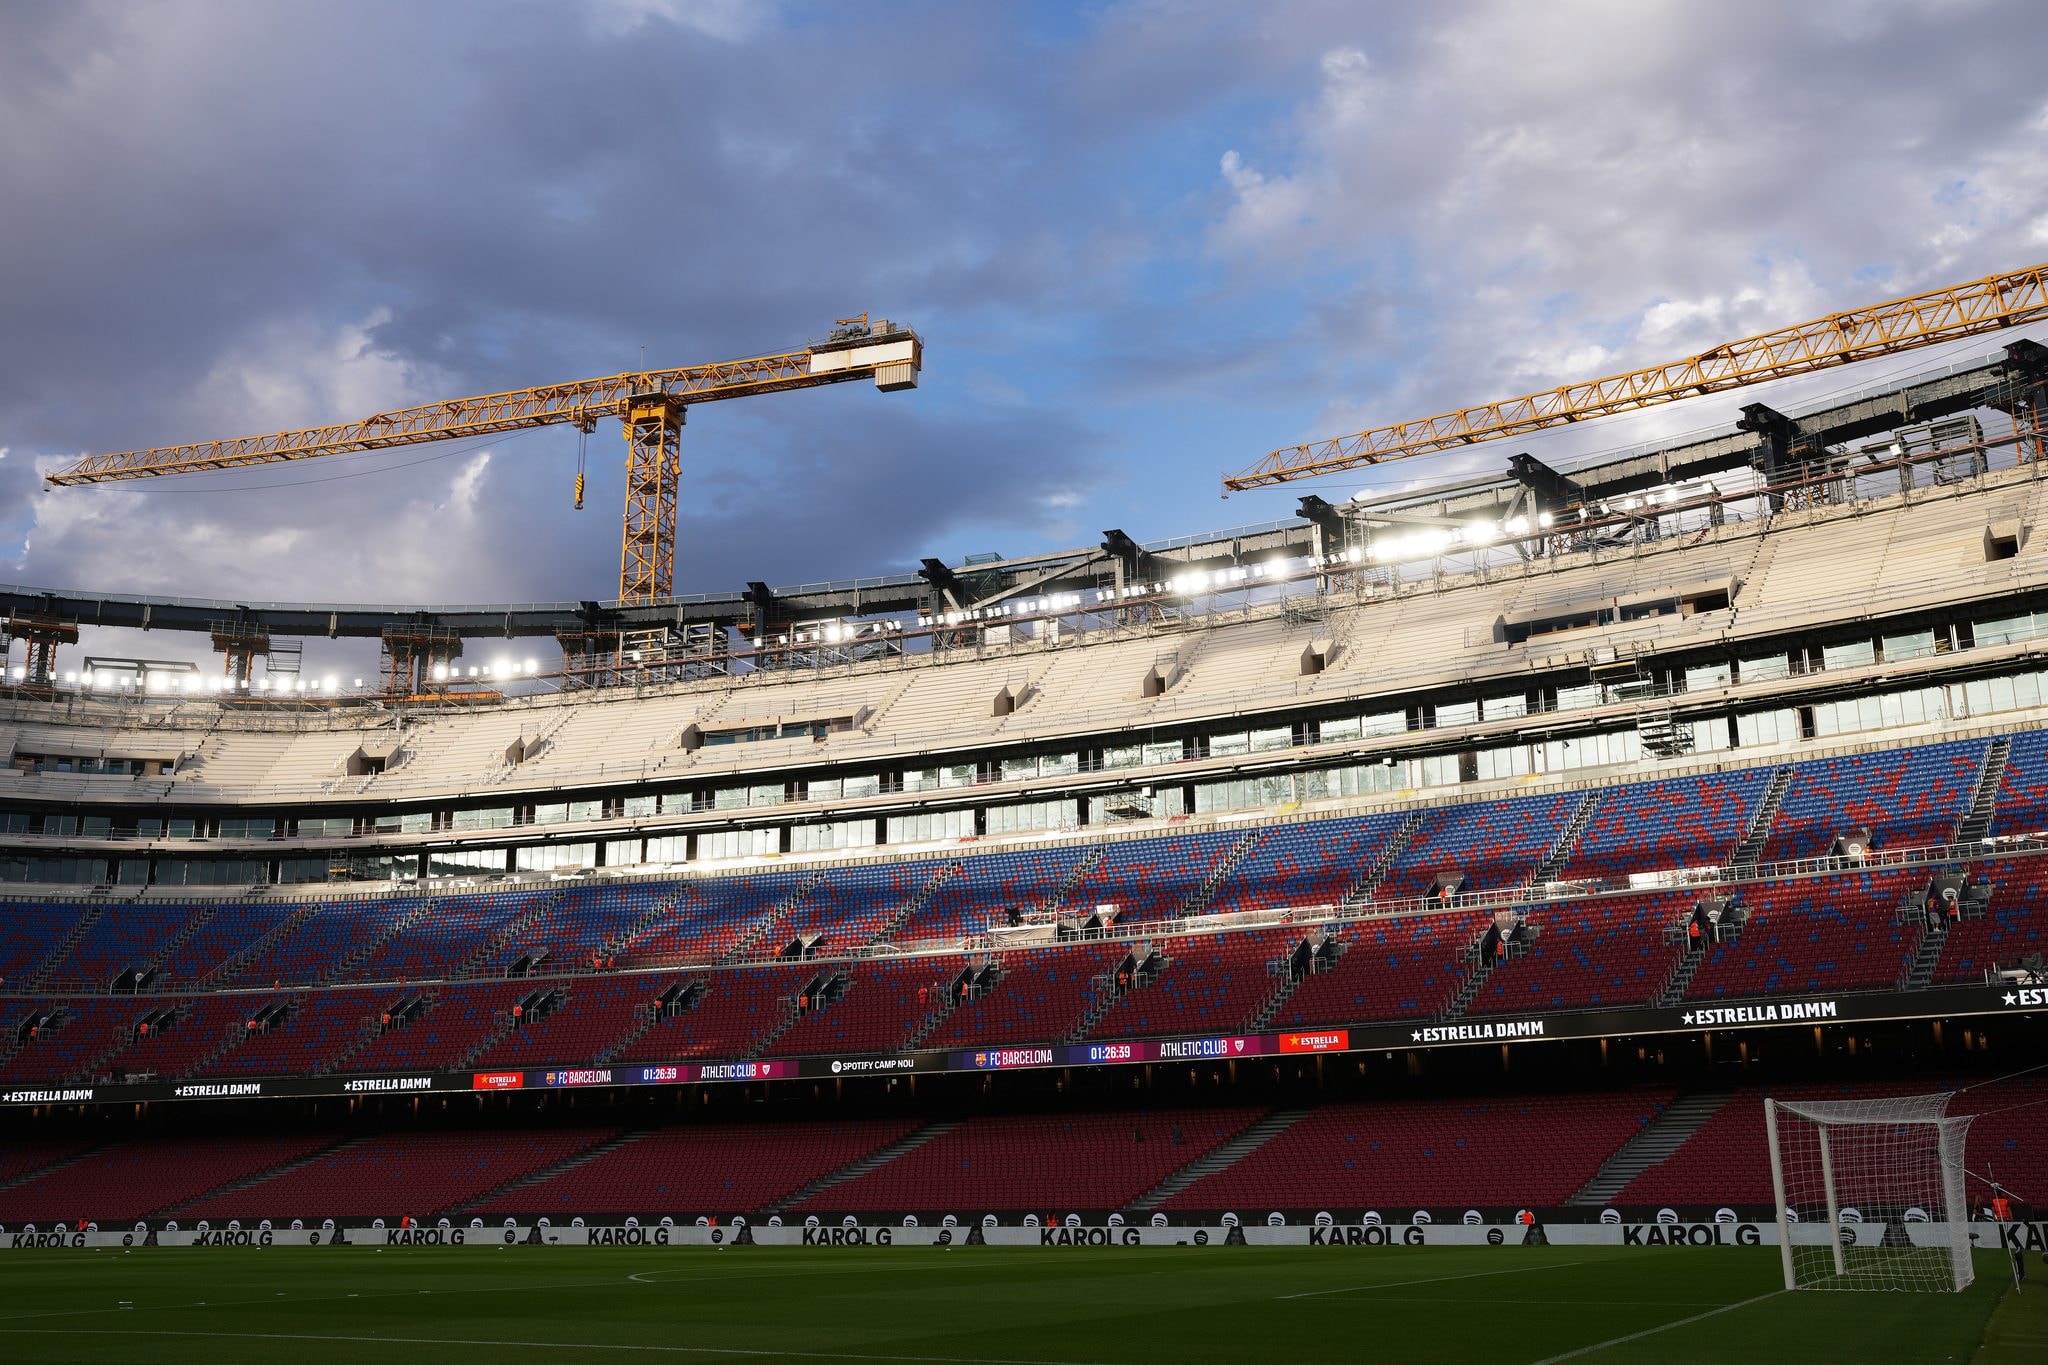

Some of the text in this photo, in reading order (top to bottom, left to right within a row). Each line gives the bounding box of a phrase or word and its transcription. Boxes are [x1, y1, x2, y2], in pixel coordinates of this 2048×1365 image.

[1695, 1001, 1837, 1025] ESTRELLA DAMM
[1423, 1020, 1545, 1042] ESTRELLA DAMM
[1300, 1035, 1339, 1045] ESTRELLA
[1090, 1045, 1131, 1060] 01:26:39
[1160, 1039, 1228, 1058] ATHLETIC CLUB
[842, 1059, 914, 1071] SPOTIFY CAMP NOU
[990, 1049, 1053, 1066] FC BARCELONA
[558, 1069, 612, 1085] FC BARCELONA
[643, 1067, 677, 1081] 01:26:39
[700, 1063, 757, 1079] ATHLETIC CLUB
[351, 1077, 432, 1091] ESTRELLA DAMM
[488, 1076, 517, 1084] ESTRELLA
[11, 1089, 93, 1102] ESTRELLA DAMM
[182, 1083, 261, 1097] ESTRELLA DAMM
[12, 1234, 85, 1248] KAROL G
[201, 1231, 272, 1245] KAROL G
[387, 1229, 464, 1245] KAROL G
[588, 1228, 668, 1245] KAROL G
[876, 1228, 891, 1245] G
[1041, 1228, 1140, 1245] KAROL G
[1310, 1226, 1424, 1245] KAROL G
[1623, 1225, 1760, 1245] KAROL G
